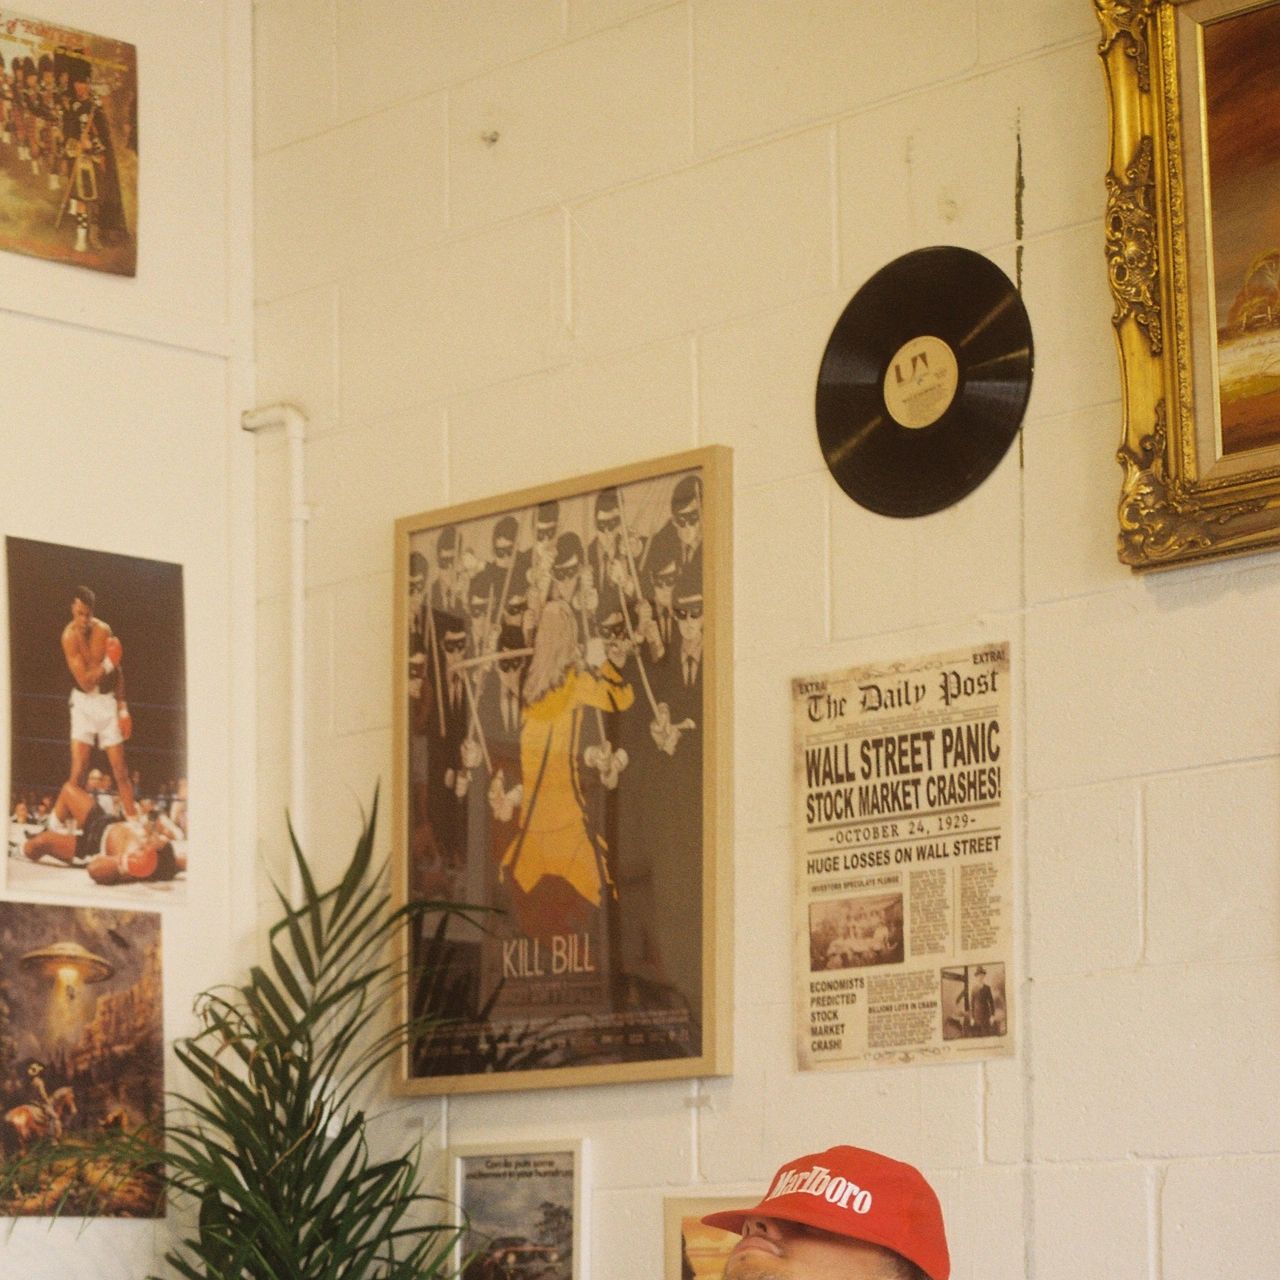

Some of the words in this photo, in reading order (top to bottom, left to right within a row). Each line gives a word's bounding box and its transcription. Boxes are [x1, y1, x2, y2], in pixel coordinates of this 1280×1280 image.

[808, 694, 847, 723] The
[858, 680, 926, 712] Daily
[939, 669, 999, 706] Post
[805, 742, 856, 789] WALL
[860, 730, 935, 780] STREET
[942, 720, 1001, 770] PANIC
[806, 787, 855, 824] STOCK
[859, 778, 922, 817] MARKET
[926, 766, 1002, 808] CRASHES!
[807, 856, 840, 876] HUGE
[844, 848, 892, 870] LOSSES
[895, 847, 913, 865] ON
[916, 843, 950, 861] WALL
[953, 834, 1002, 857] STREET
[502, 938, 545, 978] KILL
[552, 932, 595, 974] BILL
[810, 977, 865, 993] ECONOMISTS
[810, 993, 857, 1008] PREDICTED
[811, 1010, 839, 1023] STOCK
[811, 1024, 845, 1037] MARKET
[765, 1165, 872, 1214] Marlboro
